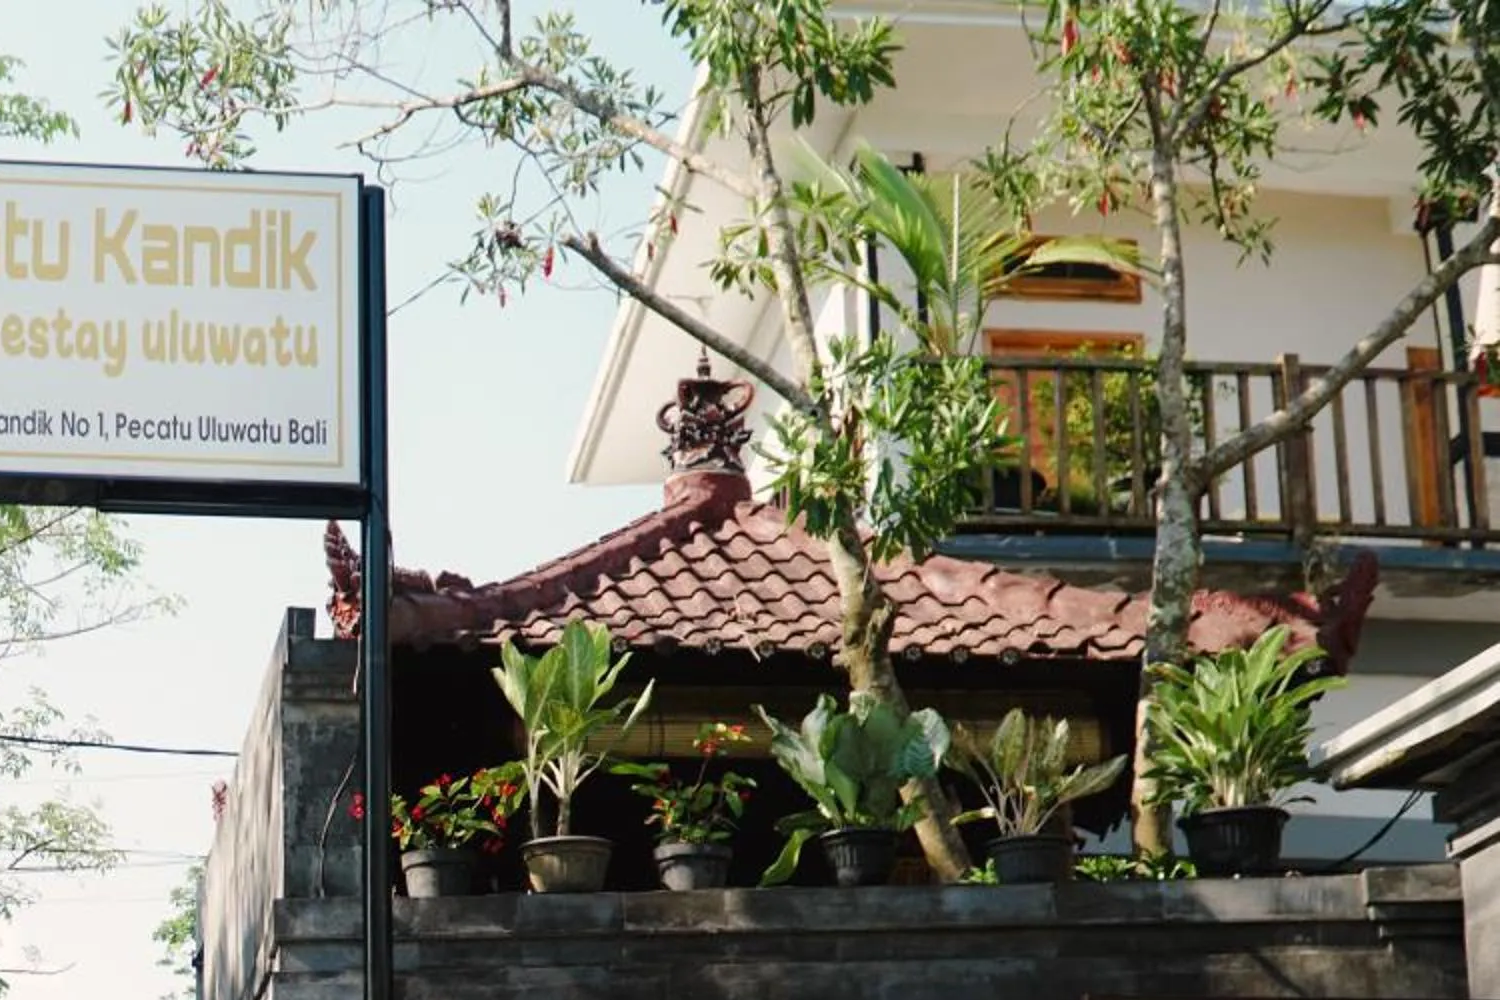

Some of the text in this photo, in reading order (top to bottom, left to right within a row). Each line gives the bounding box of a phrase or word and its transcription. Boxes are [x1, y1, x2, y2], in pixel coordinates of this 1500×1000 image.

[94, 207, 318, 291] Kandik
[142, 309, 320, 368] uluwatu
[61, 411, 90, 437] No
[115, 412, 192, 441] Pecatu
[198, 416, 284, 444] Uluwatu
[289, 419, 329, 446] Bali
